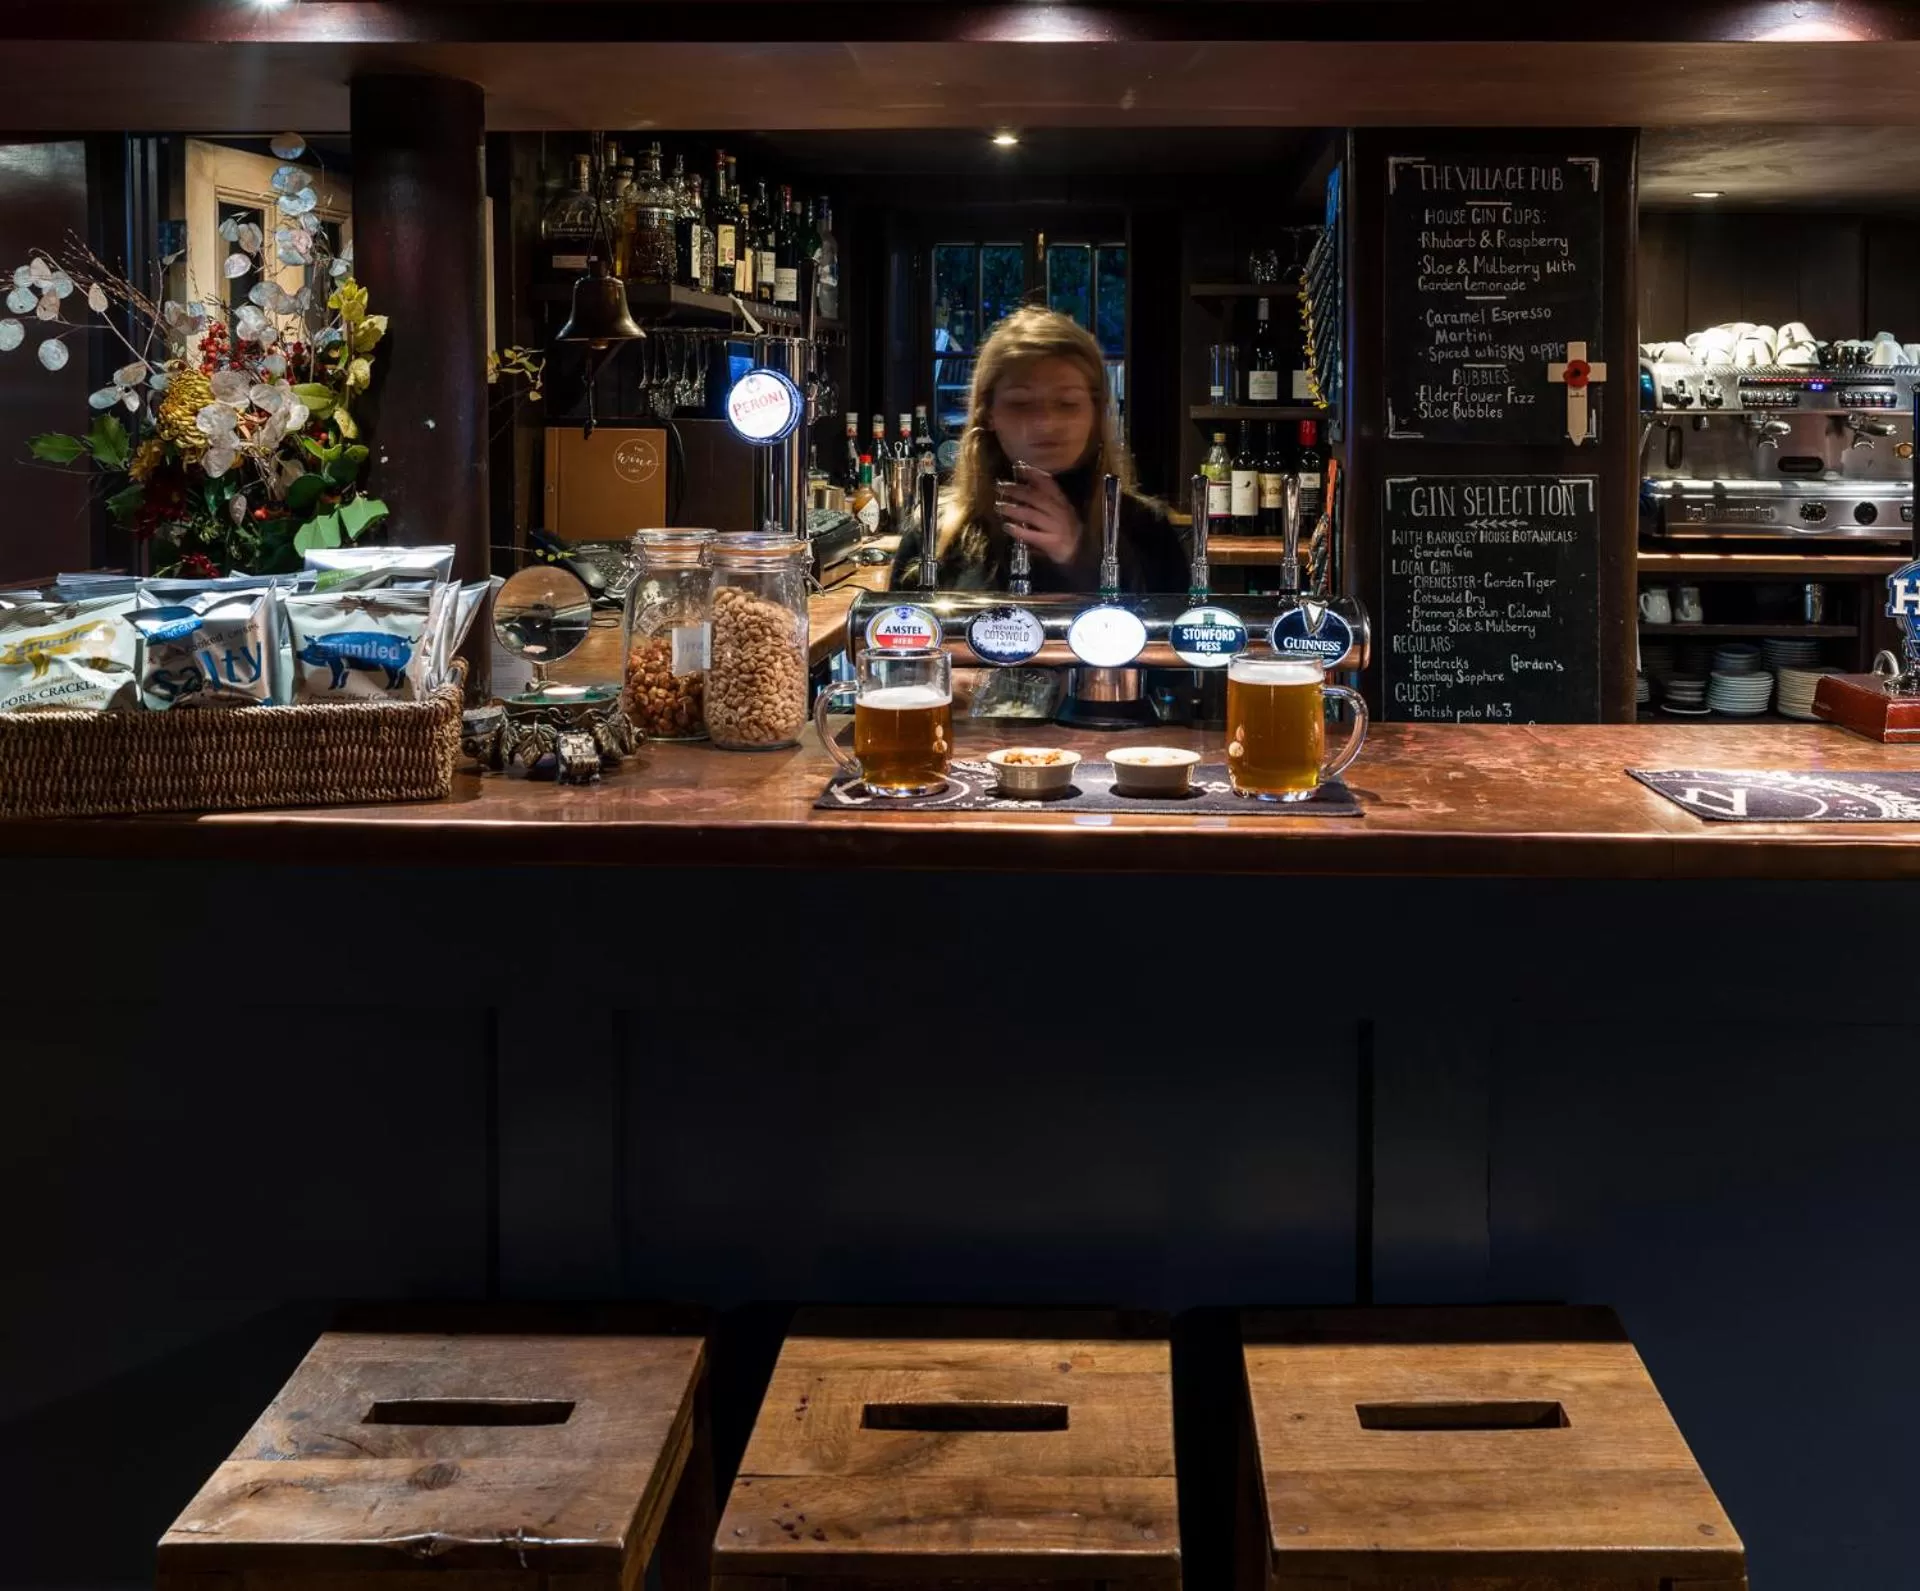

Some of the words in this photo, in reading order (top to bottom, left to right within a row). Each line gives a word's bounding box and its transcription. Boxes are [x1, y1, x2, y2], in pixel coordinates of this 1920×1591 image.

[1413, 164, 1452, 191] THE
[1456, 166, 1525, 191] VILLAGE
[1530, 166, 1564, 191] PUB
[1424, 208, 1467, 225] HOUSE
[1471, 207, 1496, 225] GIN
[1421, 230, 1477, 248] Rhubarb
[1479, 230, 1494, 248] &
[1496, 229, 1569, 256] Raspberry
[1422, 254, 1453, 275] Sloe
[1457, 258, 1471, 275] &
[1473, 255, 1540, 282] Mulberry
[1418, 275, 1462, 292] Garden
[1426, 308, 1486, 328] Caramel
[1491, 306, 1552, 324] Espresso
[1435, 328, 1492, 345] Martini
[1428, 345, 1470, 363] Spiced
[1419, 384, 1502, 403] Elderflower
[1507, 386, 1536, 405] Fizz
[733, 390, 786, 421] PERONI
[1418, 401, 1450, 419] Sloe
[1453, 401, 1503, 420] Bubbles
[1411, 485, 1456, 517] GIN
[1463, 484, 1577, 517] SELECTION
[1392, 529, 1423, 545] WITH
[1427, 529, 1477, 545] BARNSLEY
[1480, 529, 1510, 544] HOUSE
[1414, 544, 1453, 559] Garden
[1453, 543, 1473, 559] Gin
[1392, 559, 1424, 575] LOCAL
[1413, 575, 1476, 589] CIRENCESTER
[1484, 571, 1524, 589] Garden
[1523, 571, 1556, 594] Tiger
[1413, 588, 1462, 604] Cotswold
[1465, 589, 1486, 609] Dry
[1458, 607, 1465, 618] &
[1466, 605, 1498, 619] Brown
[1508, 603, 1552, 619] Colonial
[884, 625, 924, 635] AMSTEL
[983, 629, 1030, 642] COTSWOLD
[1182, 627, 1236, 642] STOWFORD
[1411, 619, 1442, 633] Chase
[1475, 622, 1483, 632] &
[1485, 619, 1536, 640] Mulberry
[1196, 641, 1221, 652] PRESS
[1283, 636, 1341, 652] GUINNESS
[1413, 654, 1470, 670] Hendricks
[1510, 653, 1564, 673] Gordon's
[1414, 670, 1453, 689] Bombay
[1456, 669, 1505, 686] Sapphire
[1413, 704, 1453, 718] British
[1457, 705, 1482, 724] polo
